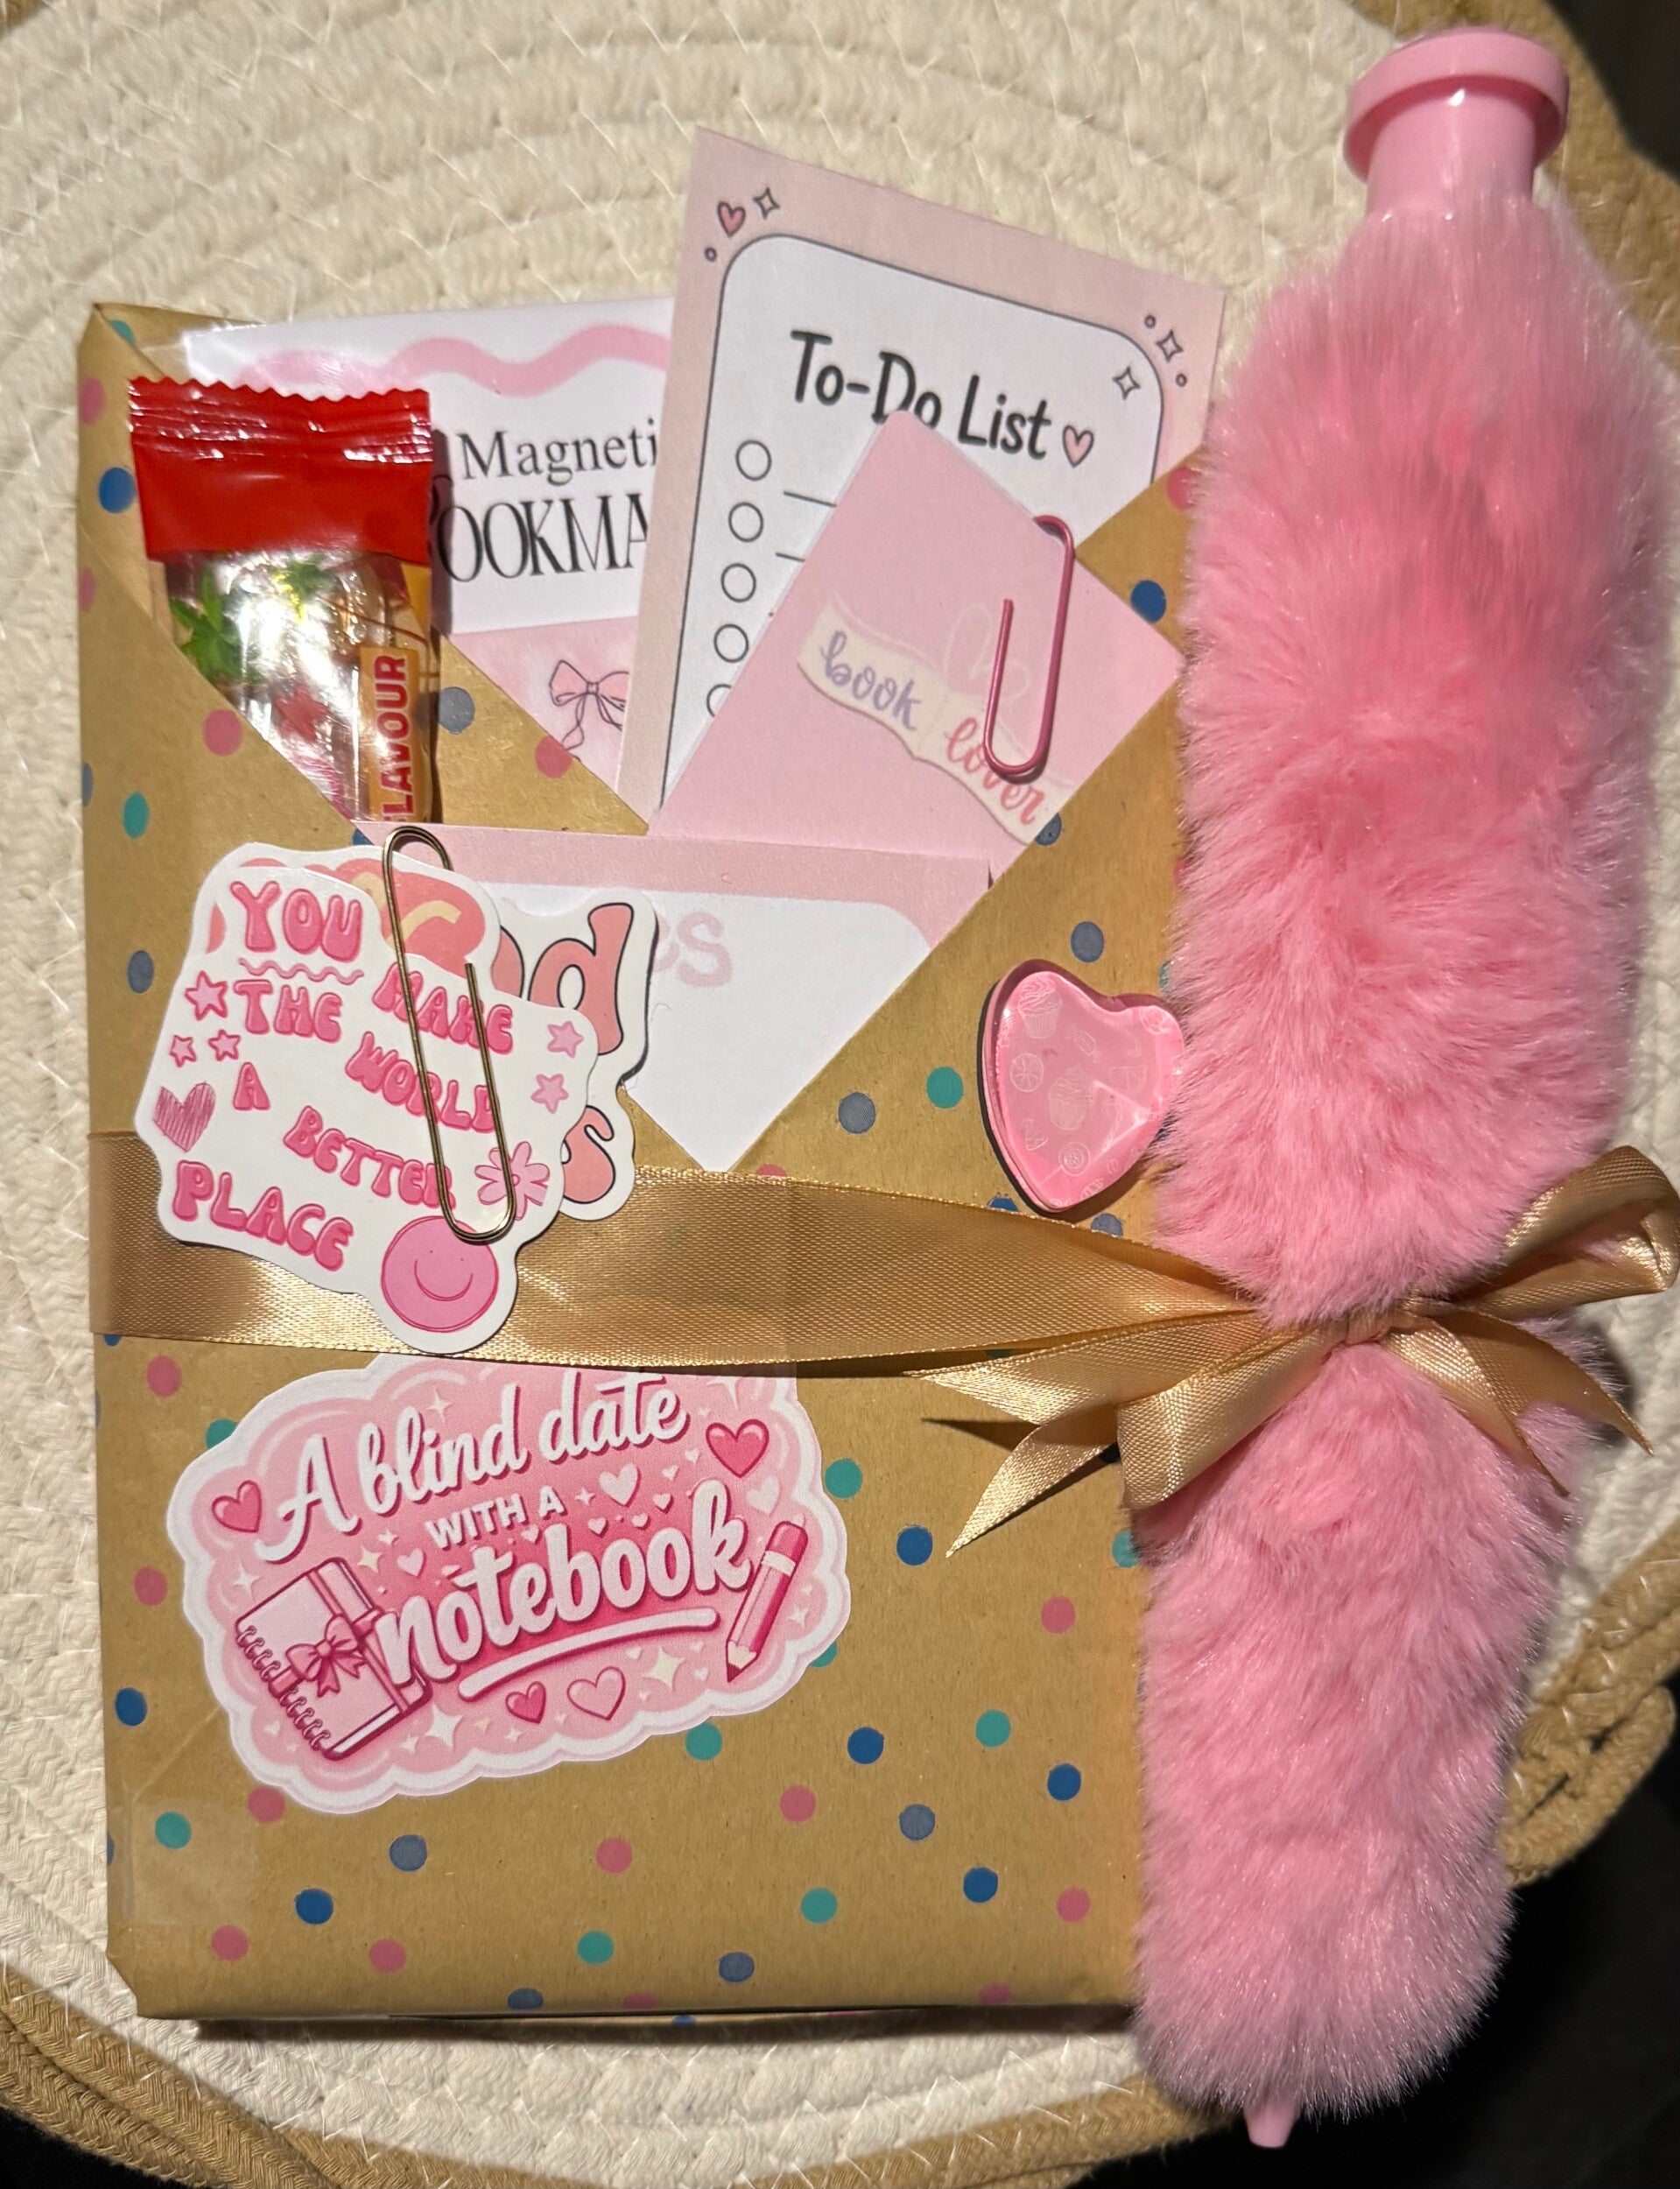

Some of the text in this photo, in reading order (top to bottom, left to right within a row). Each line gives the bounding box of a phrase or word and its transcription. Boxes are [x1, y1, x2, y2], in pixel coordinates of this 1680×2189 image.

[790, 329, 1052, 461] To-Do List
[428, 492, 649, 583] OOKMA
[373, 655, 415, 822] LAVOUR
[819, 630, 923, 731] book
[229, 880, 515, 1055] YOU MAKE
[233, 979, 496, 1133] THE WORLD
[232, 1061, 457, 1211] A BETTER
[172, 1158, 355, 1272] PLACE
[253, 1370, 691, 1565] A blind date
[425, 1486, 567, 1550] WITH A
[374, 1478, 753, 1687] notebook
